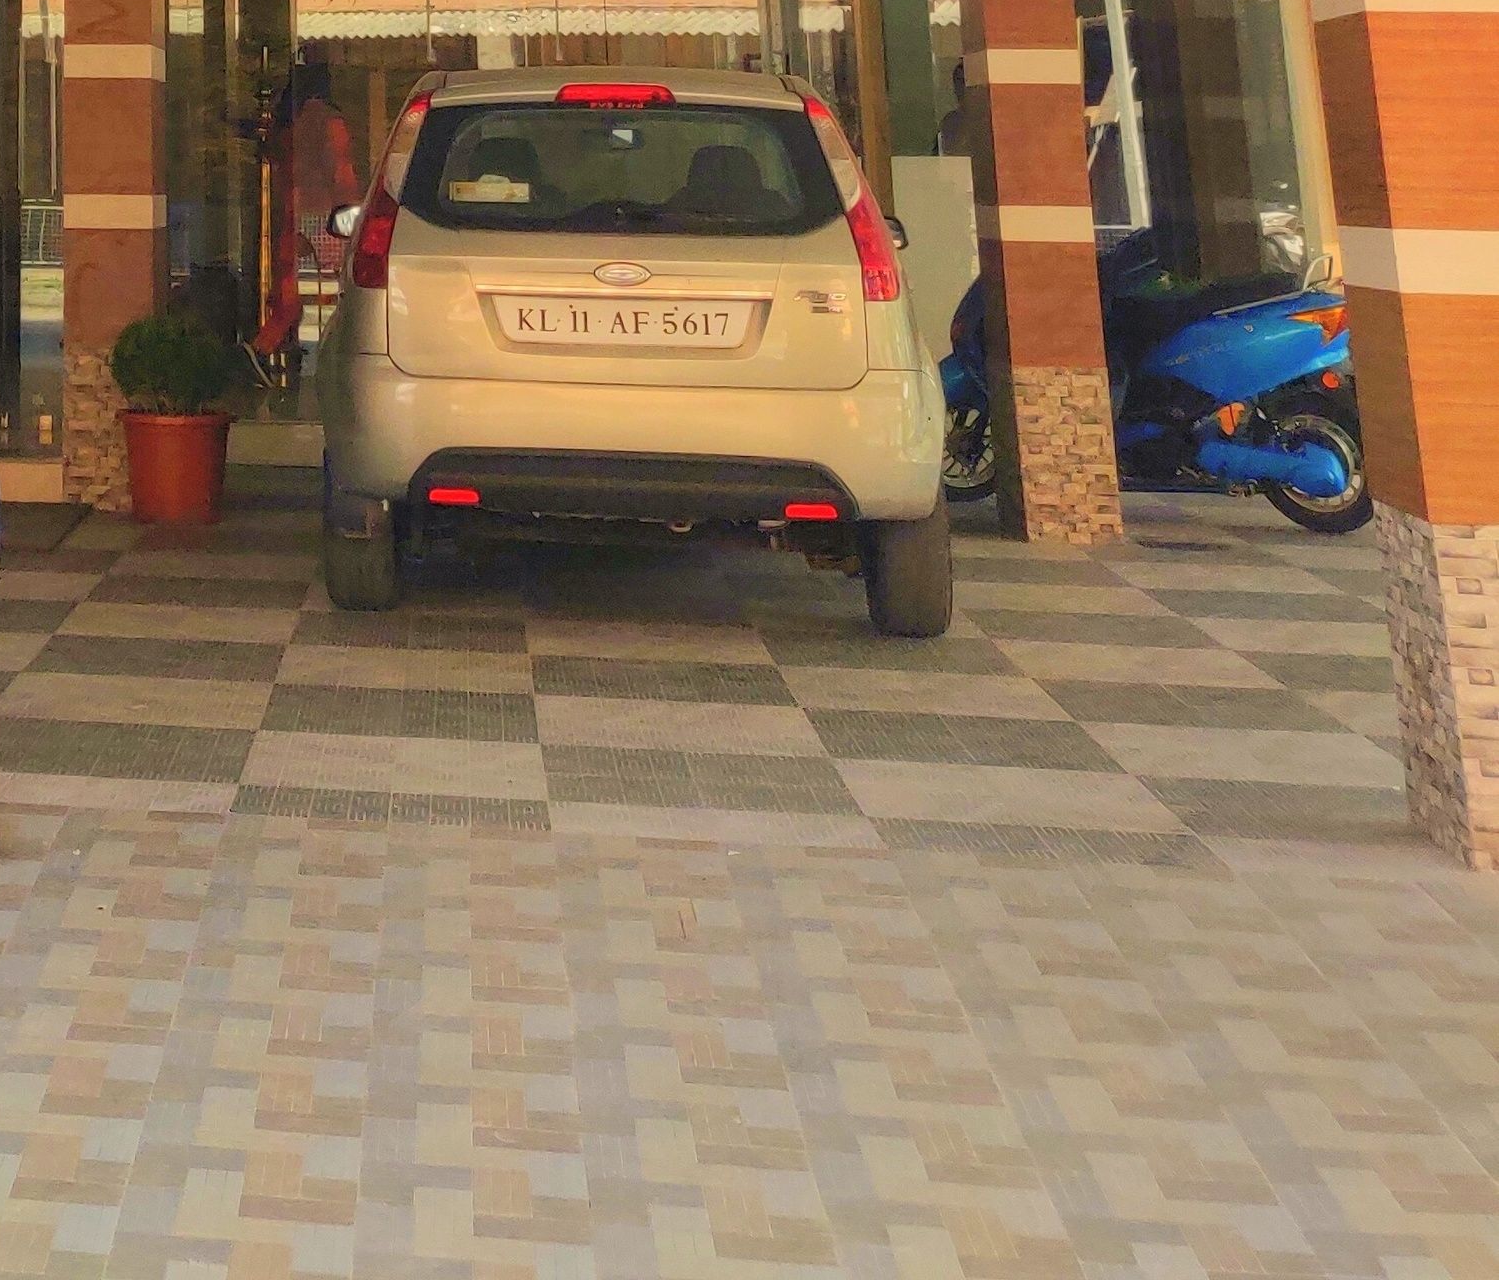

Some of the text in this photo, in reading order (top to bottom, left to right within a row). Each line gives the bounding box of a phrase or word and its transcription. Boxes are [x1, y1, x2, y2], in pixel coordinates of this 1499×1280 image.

[517, 307, 730, 337] KL 11 AF 5617
